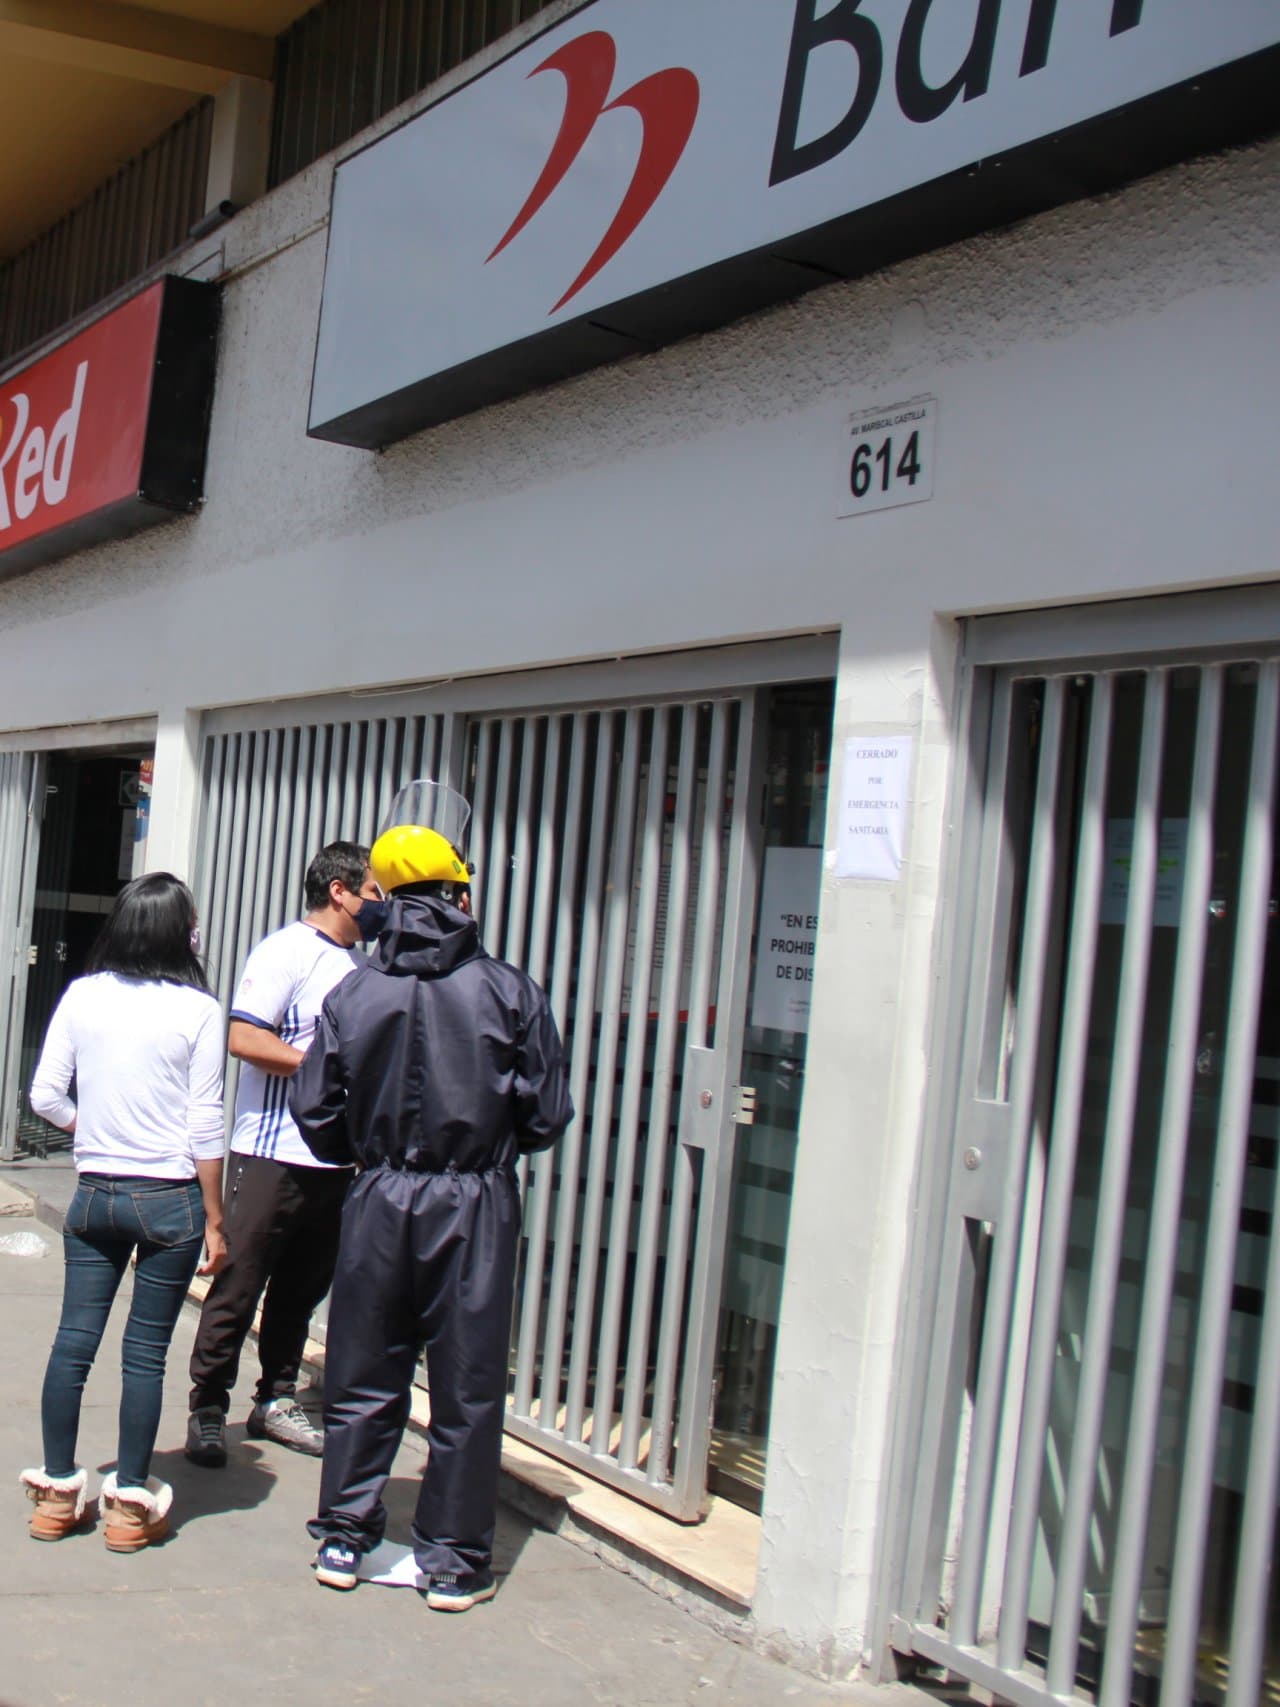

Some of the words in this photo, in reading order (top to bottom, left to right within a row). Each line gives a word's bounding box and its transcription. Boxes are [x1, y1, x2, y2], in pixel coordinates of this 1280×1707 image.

[768, 0, 1143, 188] Ba
[850, 430, 921, 498] 614
[856, 749, 899, 760] CERRADO
[867, 776, 883, 785] POR
[847, 800, 900, 810] EMERGENCIA
[848, 825, 889, 836] SANITARIA
[771, 938, 816, 957] PROHIB
[775, 965, 793, 980] DE
